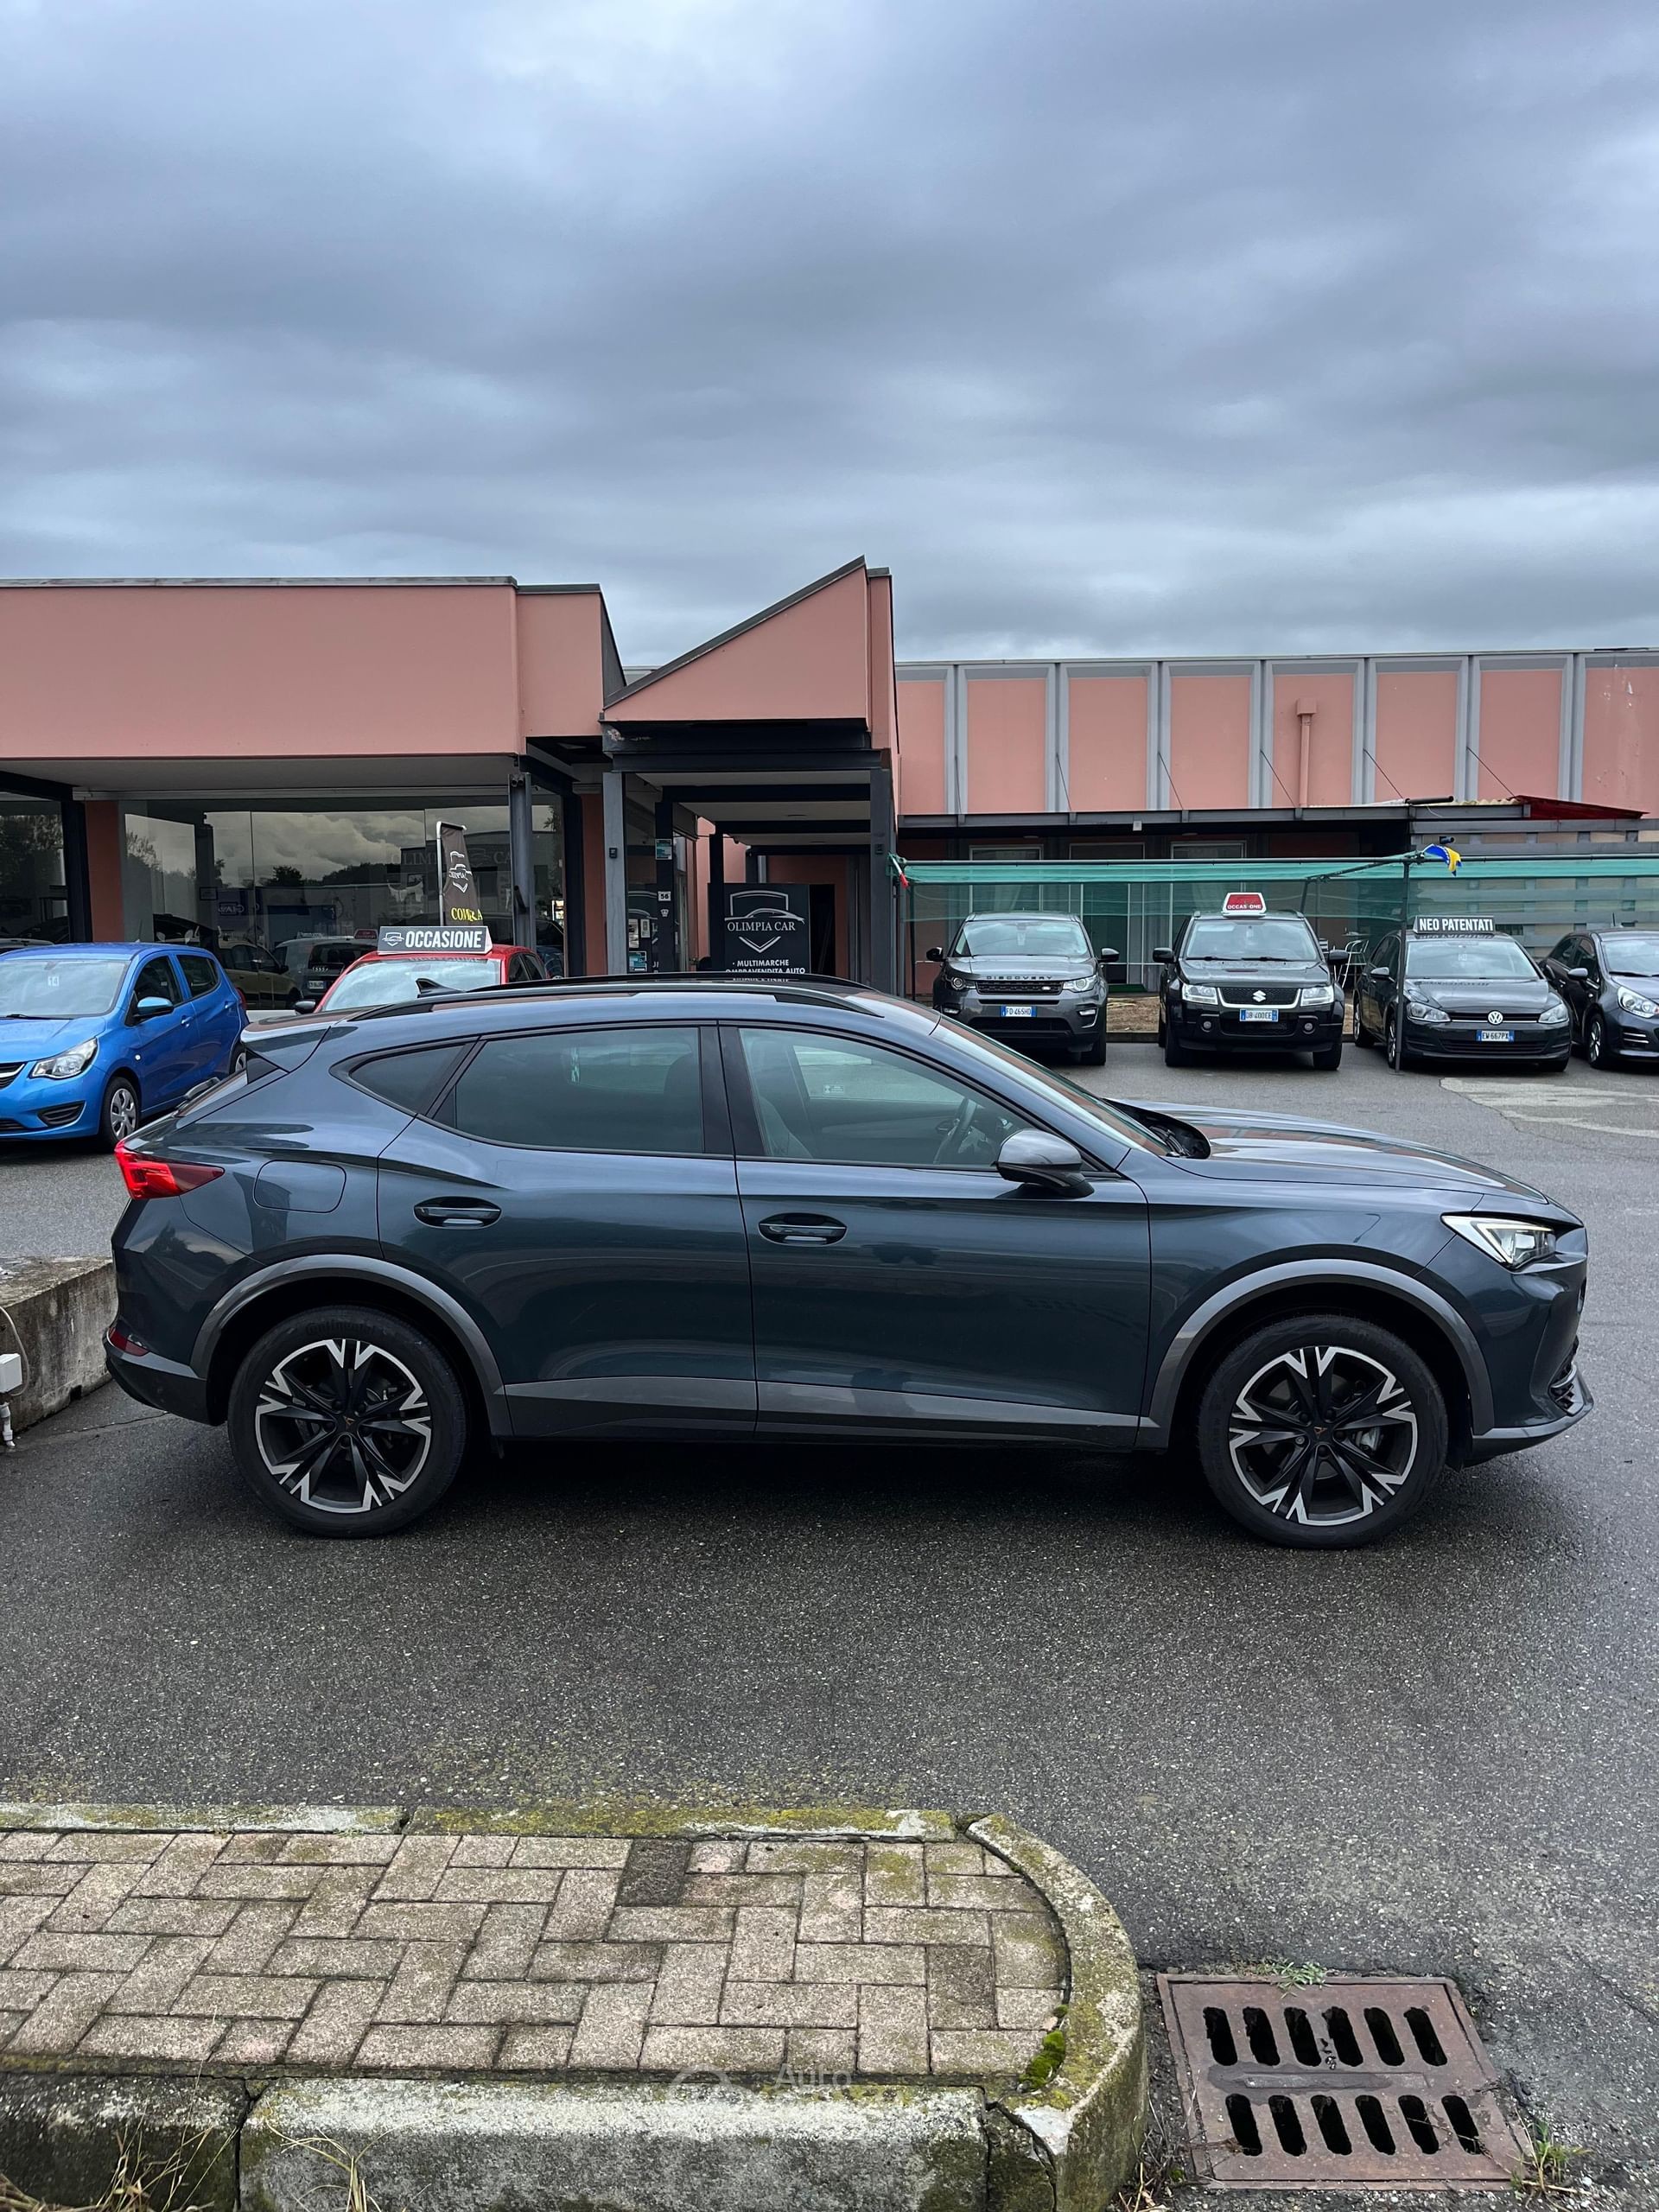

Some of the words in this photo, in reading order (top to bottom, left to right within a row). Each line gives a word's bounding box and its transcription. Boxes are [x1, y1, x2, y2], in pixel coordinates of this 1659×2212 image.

[727, 921, 772, 931] OLIMPIA
[774, 921, 796, 931] CAR
[1419, 918, 1440, 931] NEO
[1442, 918, 1493, 931] PATENTATI
[405, 931, 482, 948] OCCASIONE
